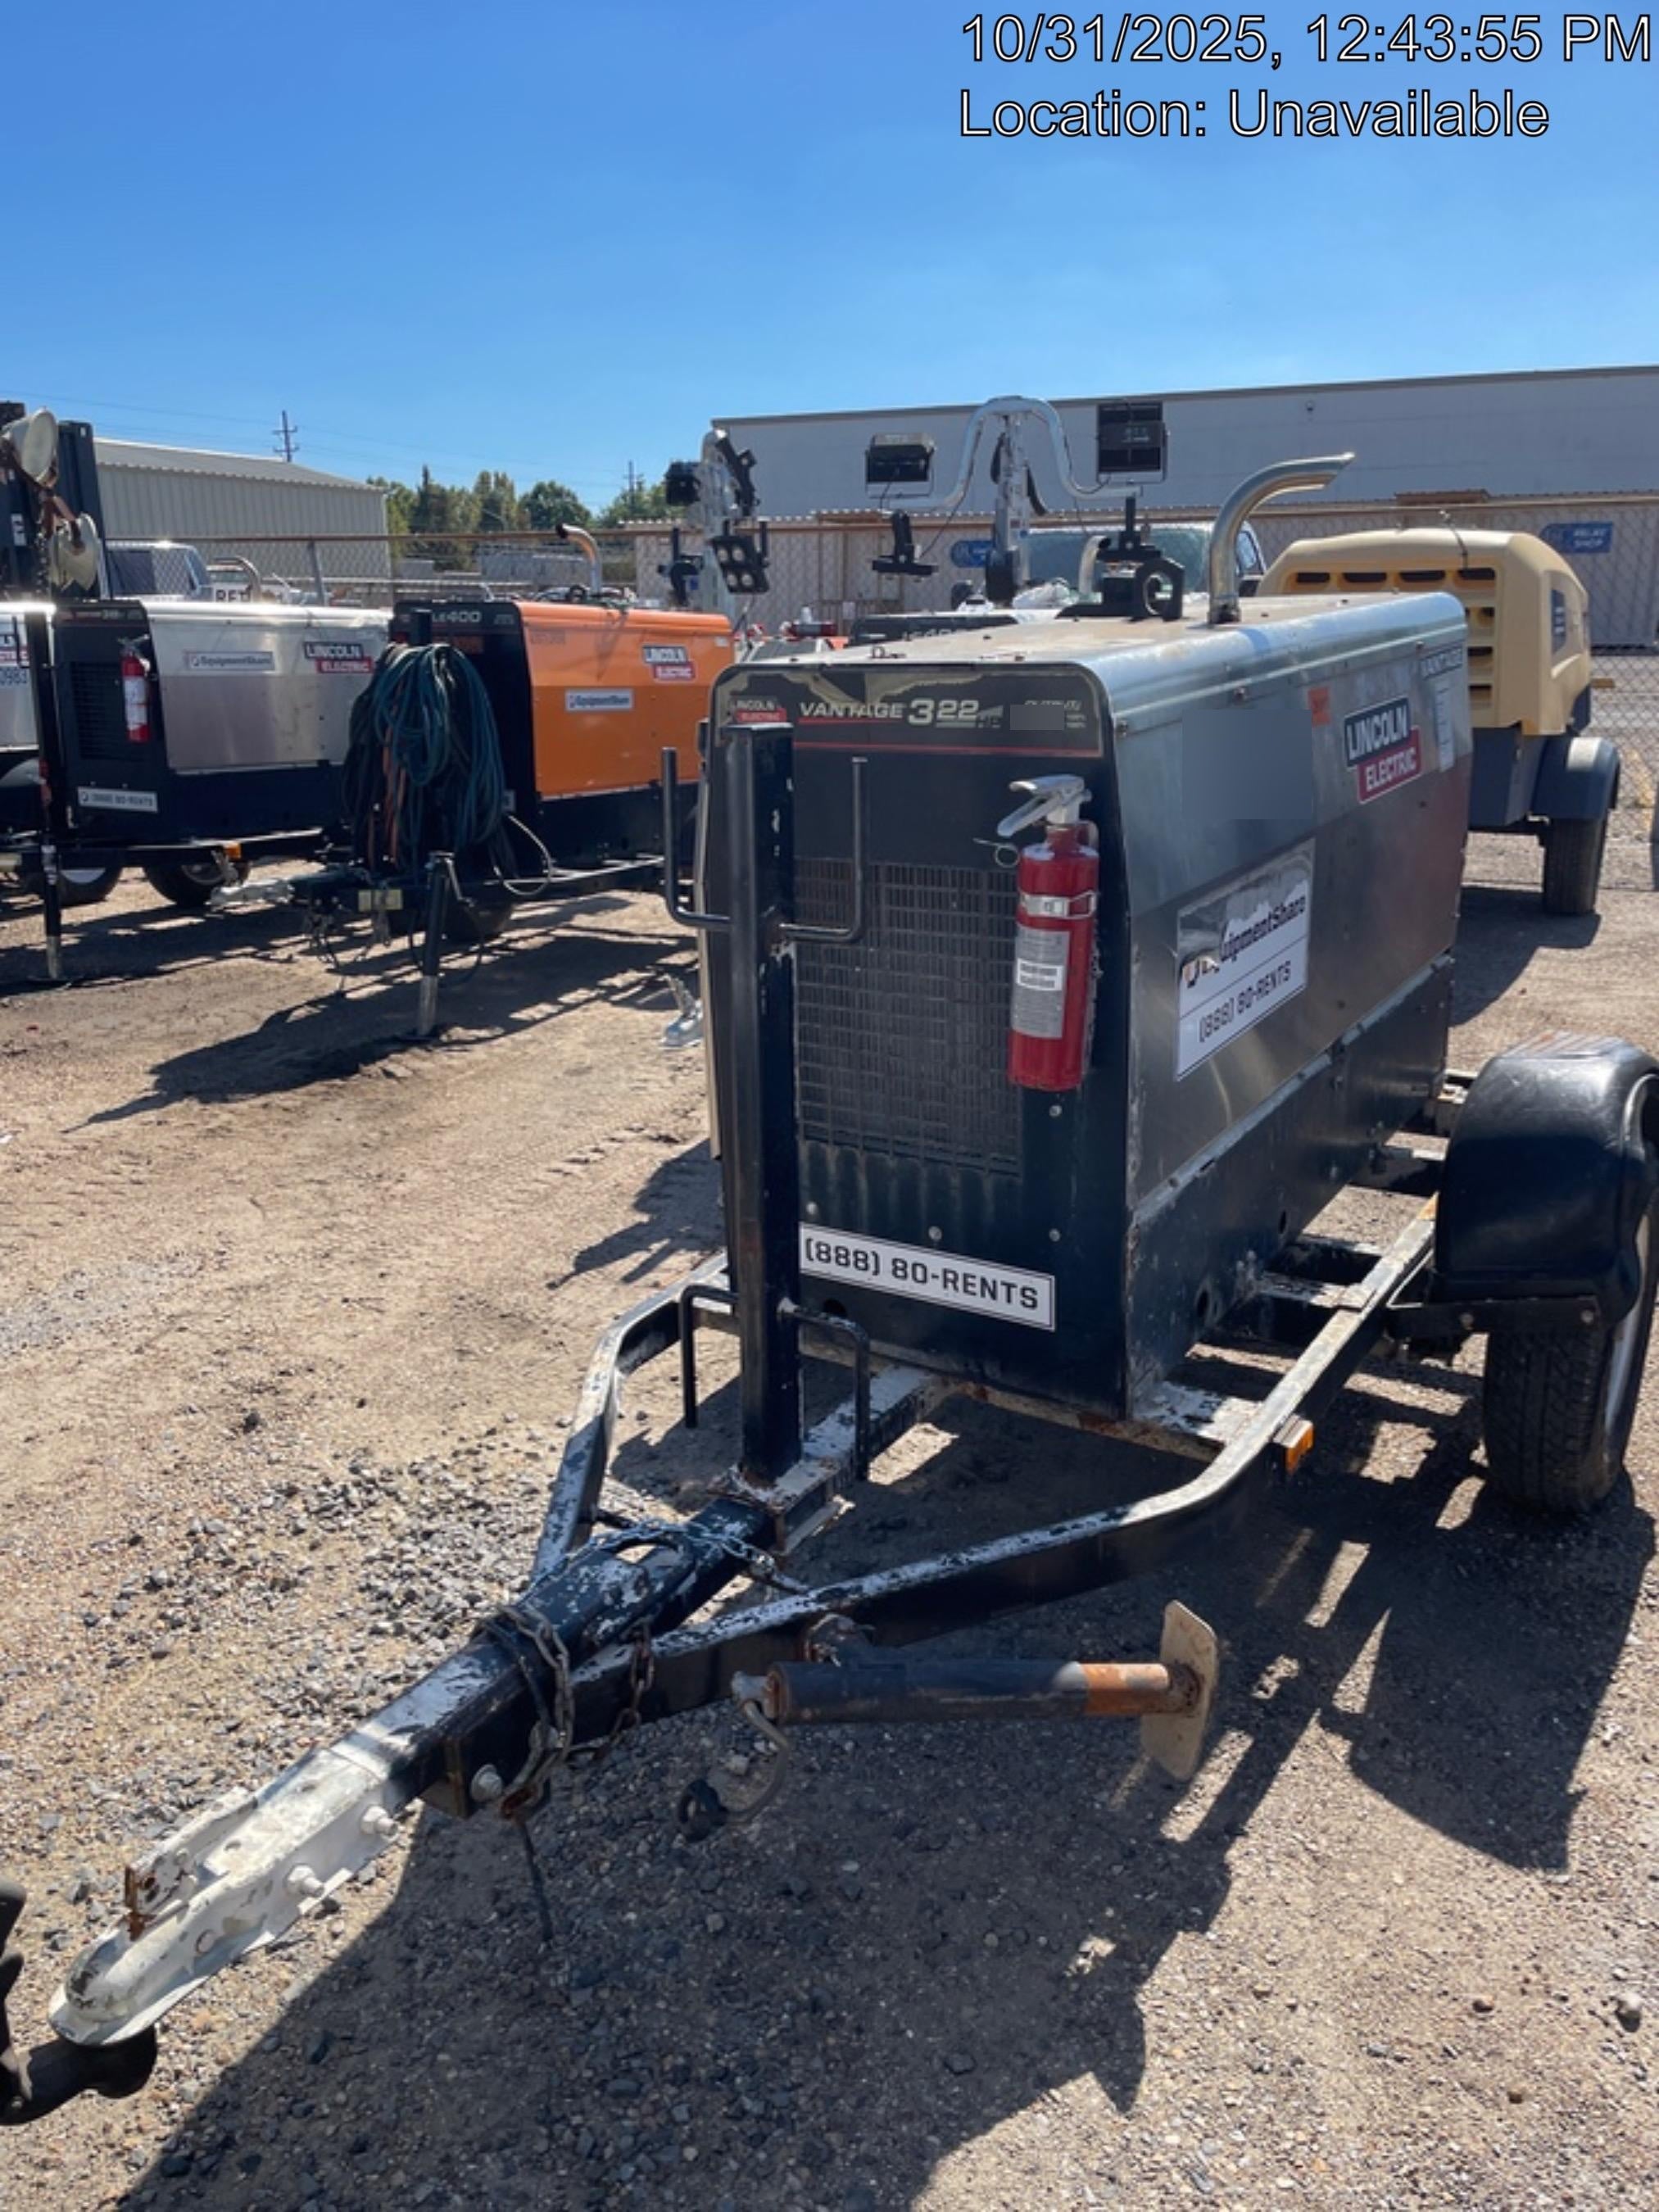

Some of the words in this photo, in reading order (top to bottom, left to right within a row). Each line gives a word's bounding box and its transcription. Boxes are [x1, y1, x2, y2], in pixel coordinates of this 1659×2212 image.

[799, 702, 904, 718] VANTAGE
[908, 698, 979, 726] 322
[1346, 704, 1408, 761] LINCOLN
[1366, 746, 1416, 792] ELECTRIC
[1199, 998, 1235, 1043] (888)
[1237, 960, 1292, 1015] 80-RENTS
[805, 1237, 880, 1276] (888)
[891, 1257, 1038, 1311] 80-RENTS
